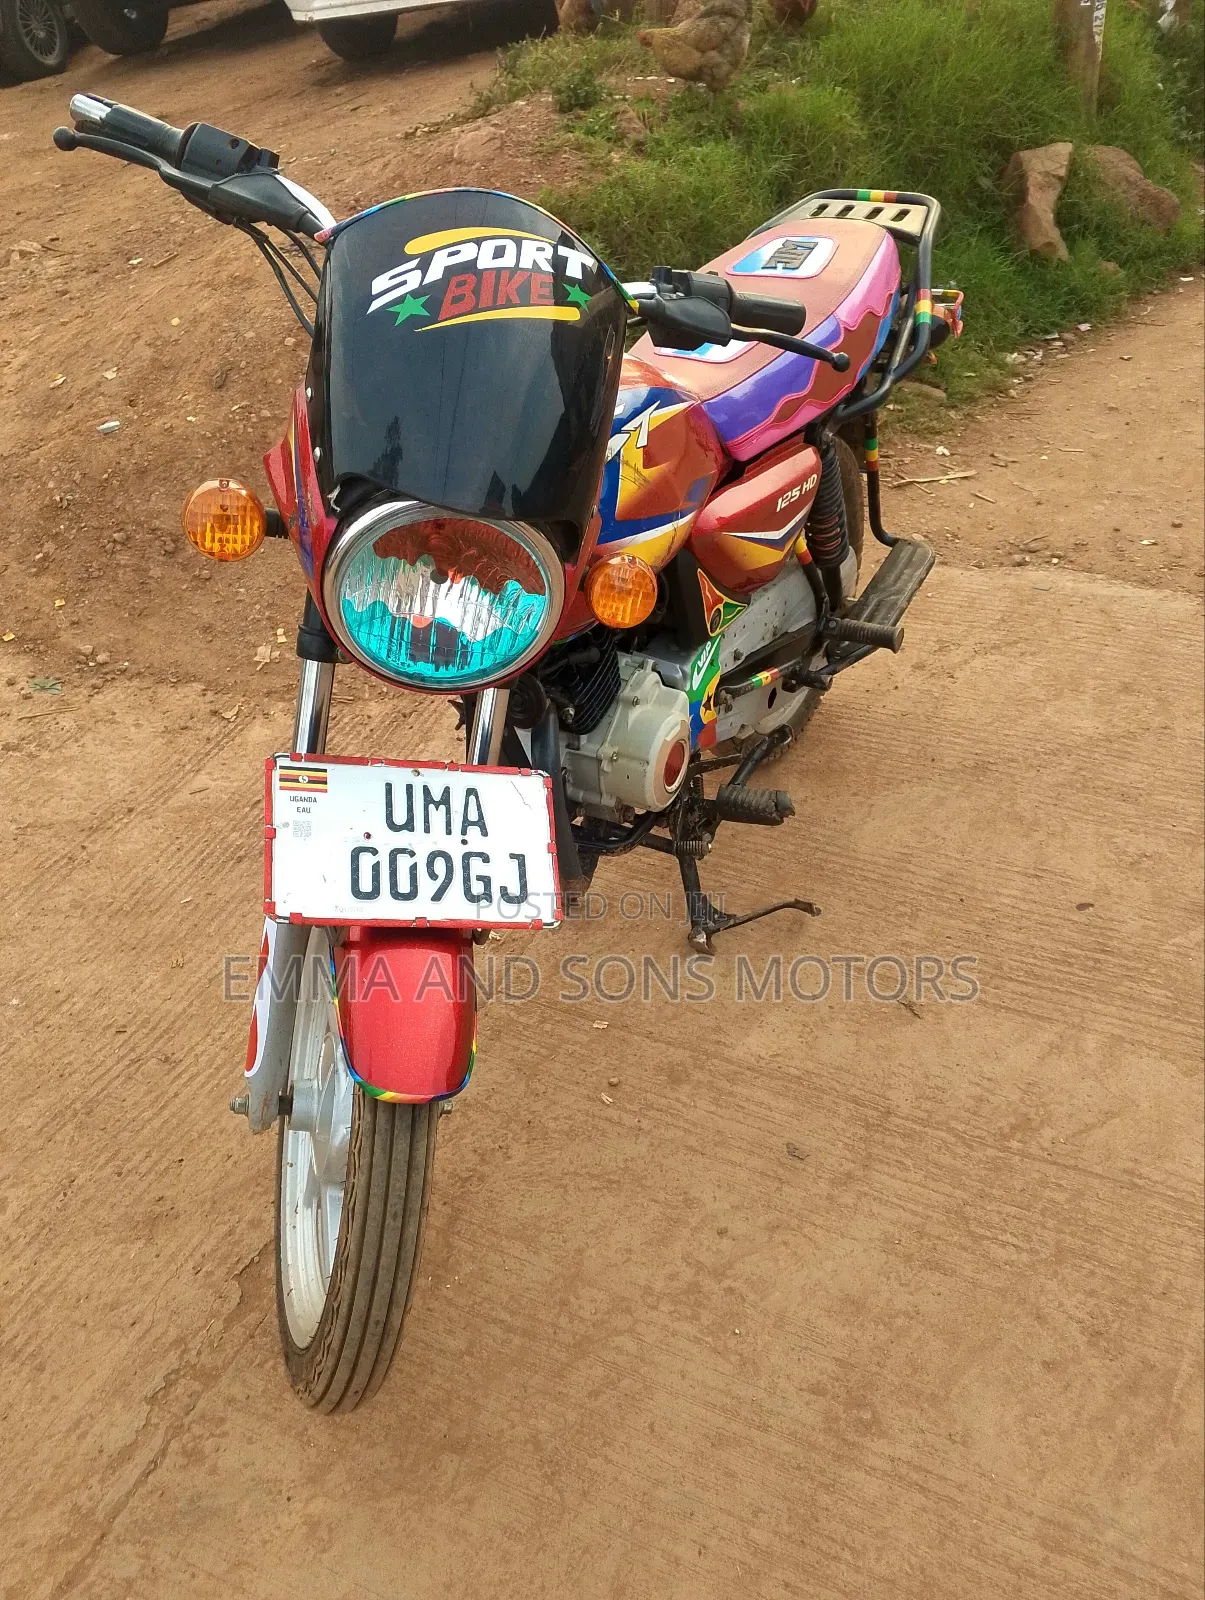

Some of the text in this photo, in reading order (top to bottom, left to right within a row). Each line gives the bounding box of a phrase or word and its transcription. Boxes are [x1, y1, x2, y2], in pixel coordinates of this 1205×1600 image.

[366, 238, 595, 315] SPORT
[437, 270, 555, 321] BIKE
[776, 474, 818, 512] 125 HD
[289, 795, 318, 803] UGANDA
[296, 806, 311, 814] EAU
[385, 782, 489, 837] UMA
[351, 846, 529, 905] 009GJ
